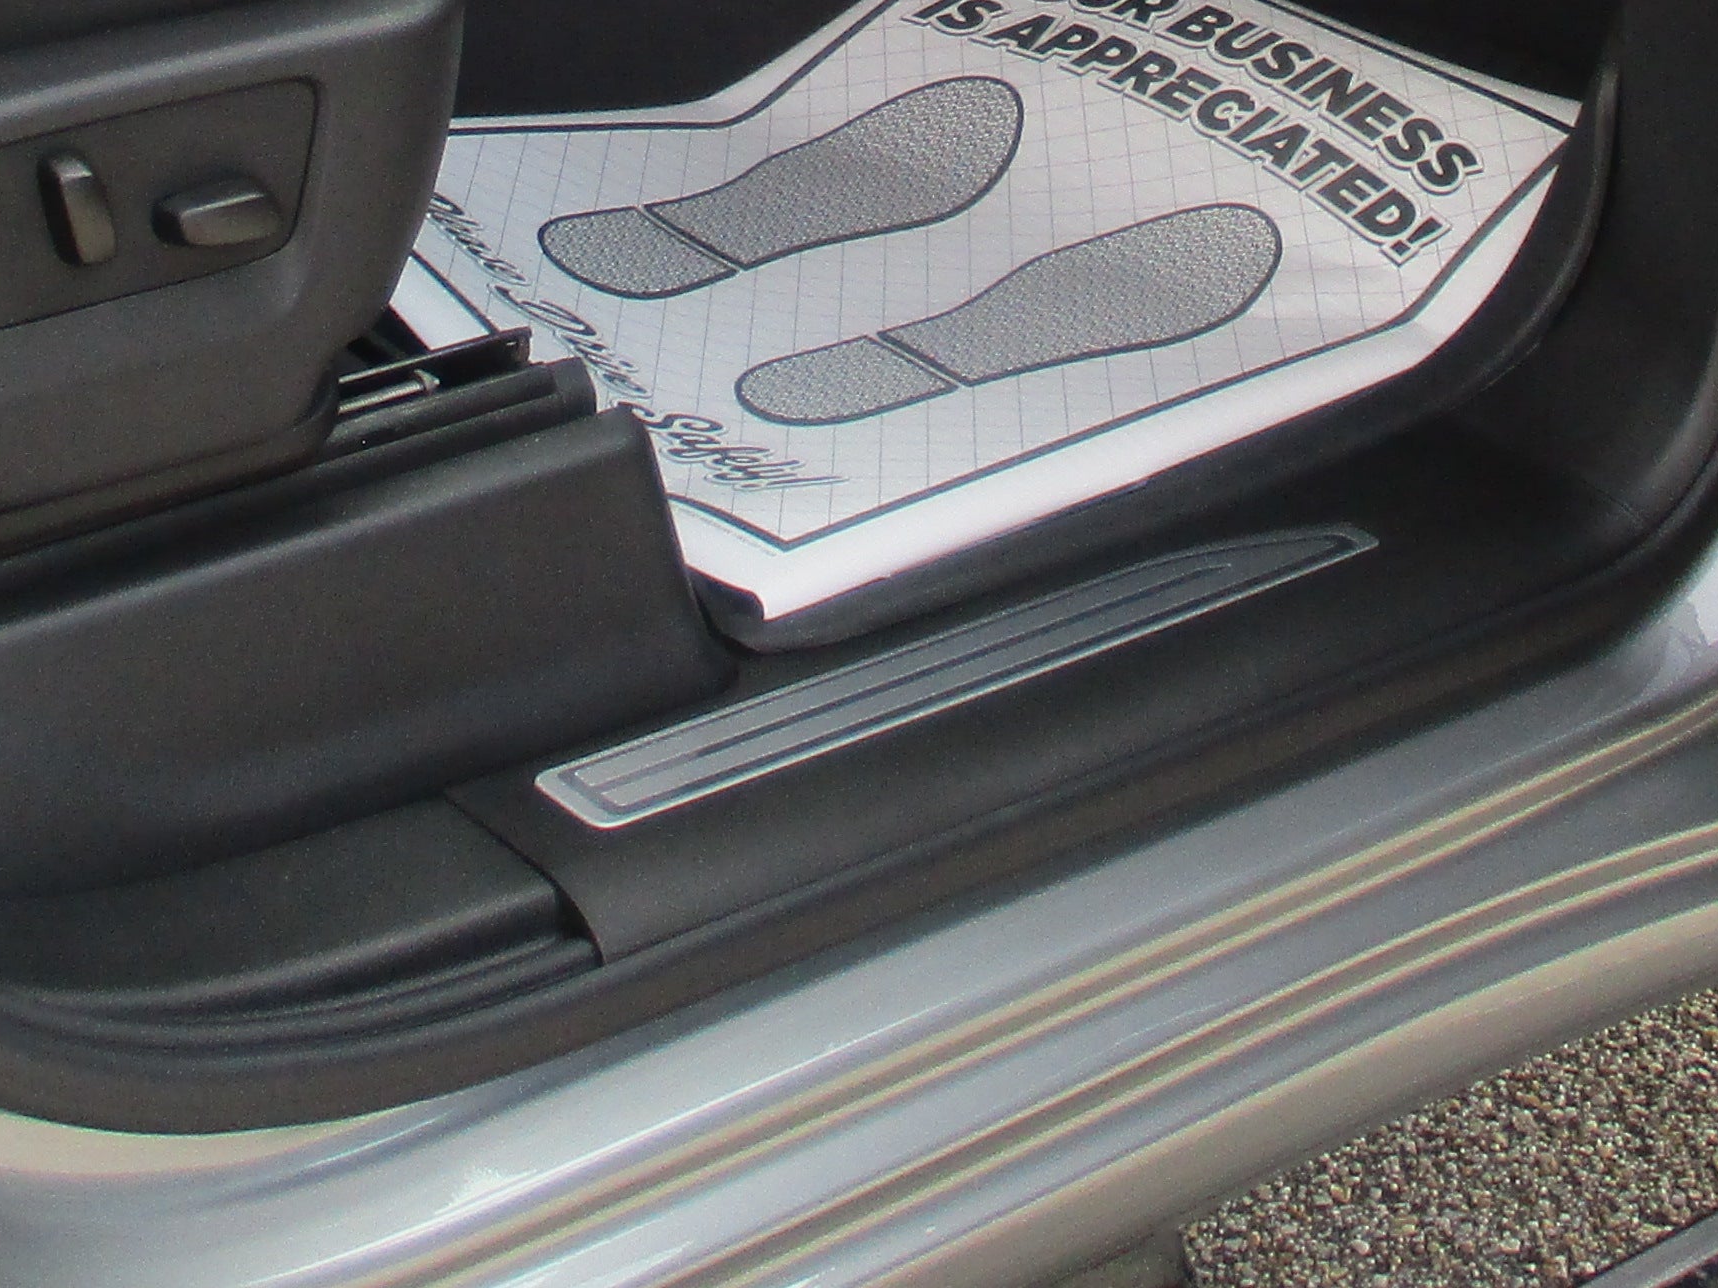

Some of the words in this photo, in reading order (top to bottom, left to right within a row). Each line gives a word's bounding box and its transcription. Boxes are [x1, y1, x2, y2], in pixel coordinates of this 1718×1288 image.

[982, 13, 1449, 261] APPRECIATED!
[1163, 3, 1480, 191] BUSINESS
[612, 400, 847, 490] Safely!
